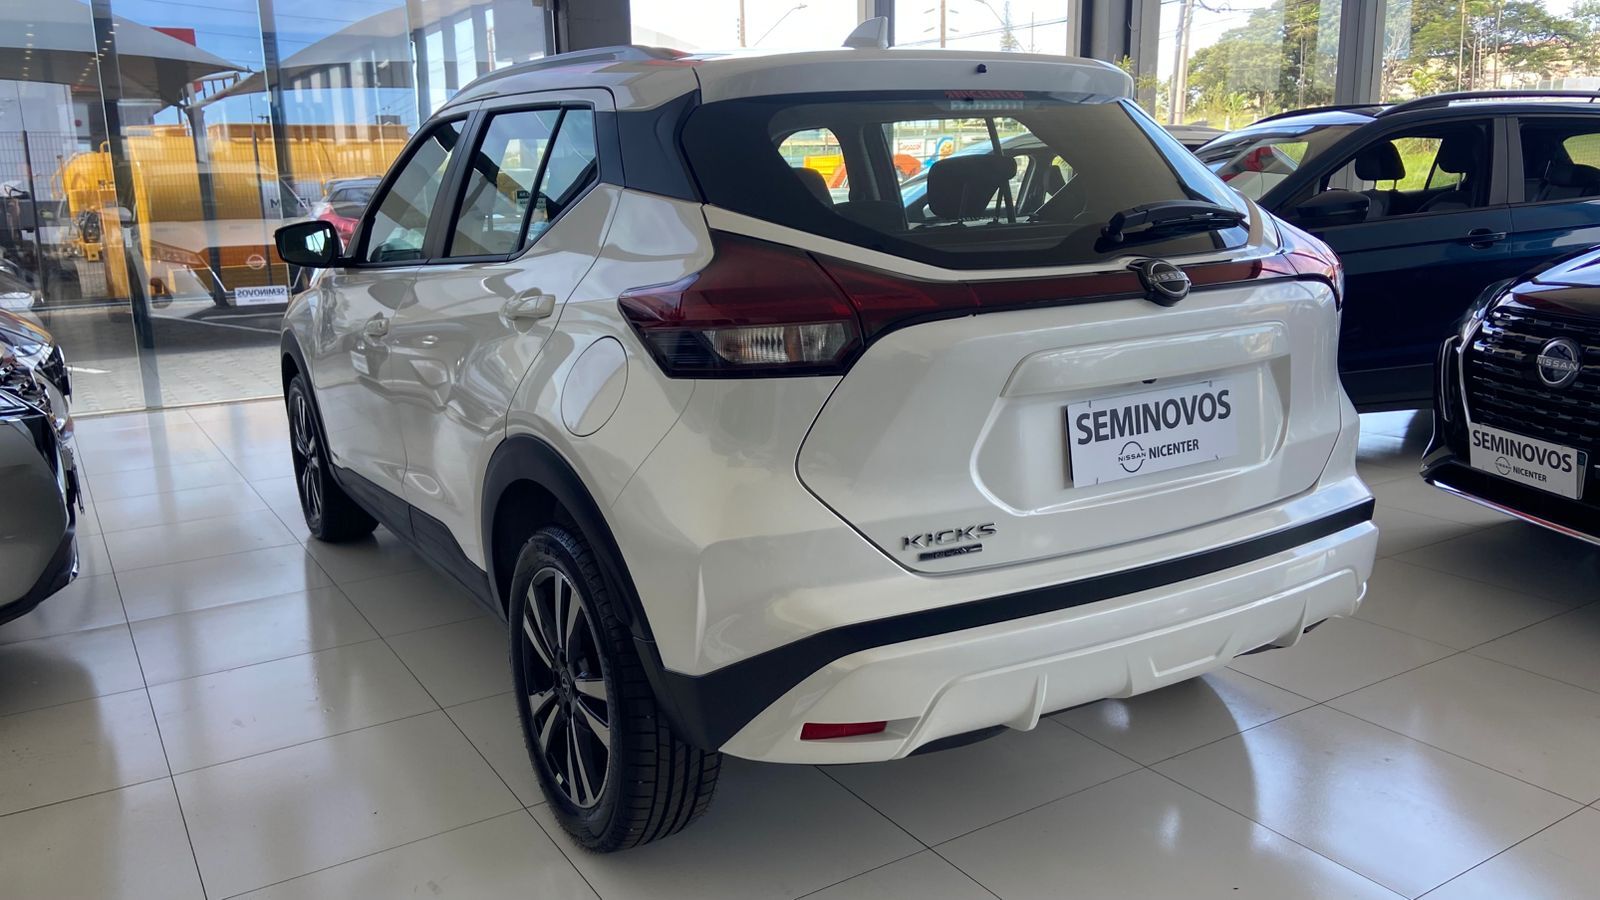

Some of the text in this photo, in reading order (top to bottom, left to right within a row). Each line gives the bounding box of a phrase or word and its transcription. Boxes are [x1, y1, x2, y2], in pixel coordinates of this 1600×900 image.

[1537, 355, 1578, 371] NISSAN
[1076, 389, 1231, 445] SEMINOVOS
[1118, 438, 1199, 462] NISSAN NICENTER
[1472, 429, 1572, 473] SEMINOVOS
[1513, 465, 1547, 482] NICENTER
[901, 522, 996, 551] KICKS
